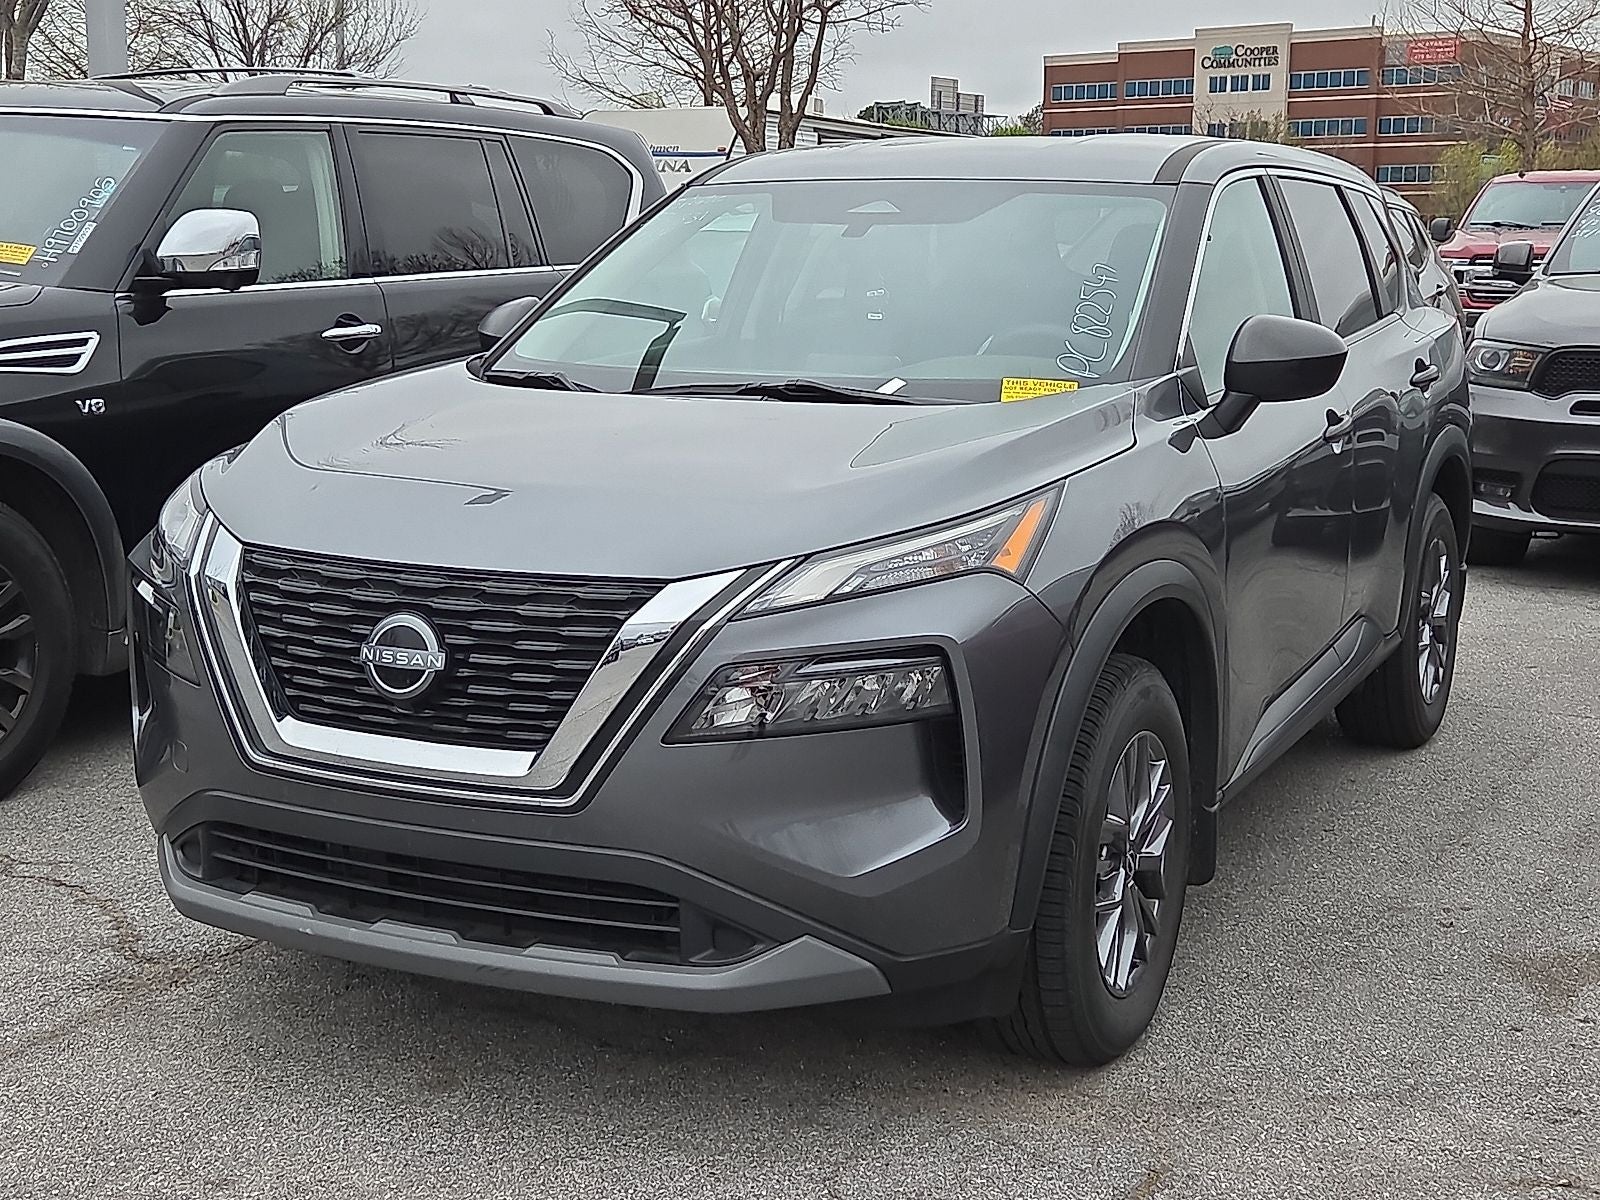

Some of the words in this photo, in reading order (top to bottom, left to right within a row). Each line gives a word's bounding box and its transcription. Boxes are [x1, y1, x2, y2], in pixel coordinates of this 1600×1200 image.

[1234, 44, 1279, 57] COOPER
[1200, 56, 1279, 69] COMMUNITIES
[1056, 262, 1119, 378] PC822547
[75, 398, 106, 414] V8
[362, 646, 443, 668] NISSAN
